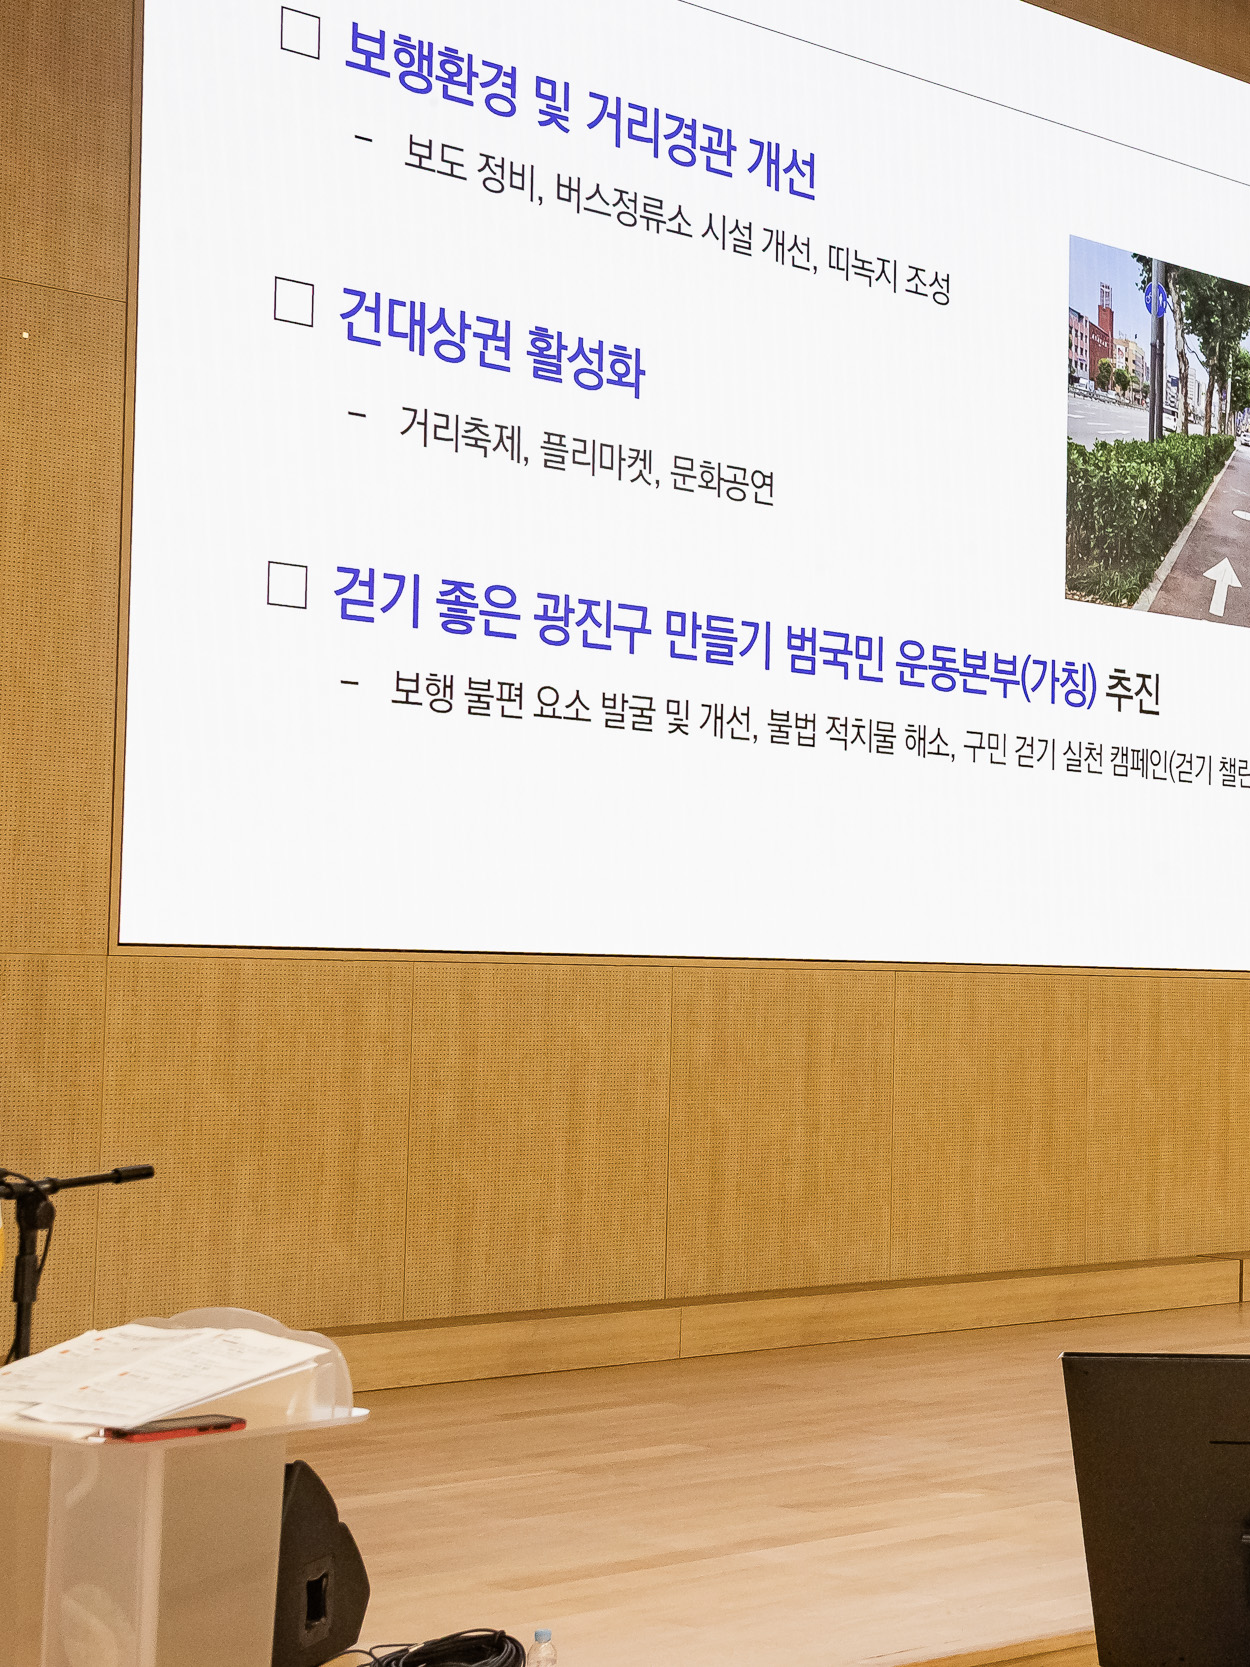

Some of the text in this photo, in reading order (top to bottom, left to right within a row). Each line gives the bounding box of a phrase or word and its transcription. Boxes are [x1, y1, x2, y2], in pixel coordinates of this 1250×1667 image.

[346, 22, 815, 200] 보행환경 및 거리경관 개선
[405, 134, 949, 305] 보도 정비, 버스정류소 시설 개선, 띠녹지 조성
[340, 288, 645, 399] 건대상권 활성화
[400, 407, 773, 506] 거리축제, 플리마켓, 문화공연
[334, 566, 1159, 715] 걷기 좋은 광진구 만들기 범국민 운동본부(가칭) 추진
[392, 671, 453, 713] 보행
[464, 677, 522, 719] 불편
[534, 686, 591, 722] 요소
[602, 692, 656, 732] 발굴
[667, 700, 688, 735] 및
[700, 704, 757, 743] 개선,
[768, 709, 815, 747] 불법
[826, 716, 896, 755] 적치물
[905, 724, 954, 762] 해소,
[964, 731, 1006, 765] 구민
[1015, 736, 1055, 770] 걷기
[1063, 741, 1102, 774] 실천
[1111, 746, 1211, 785] 캠페인(걷기
